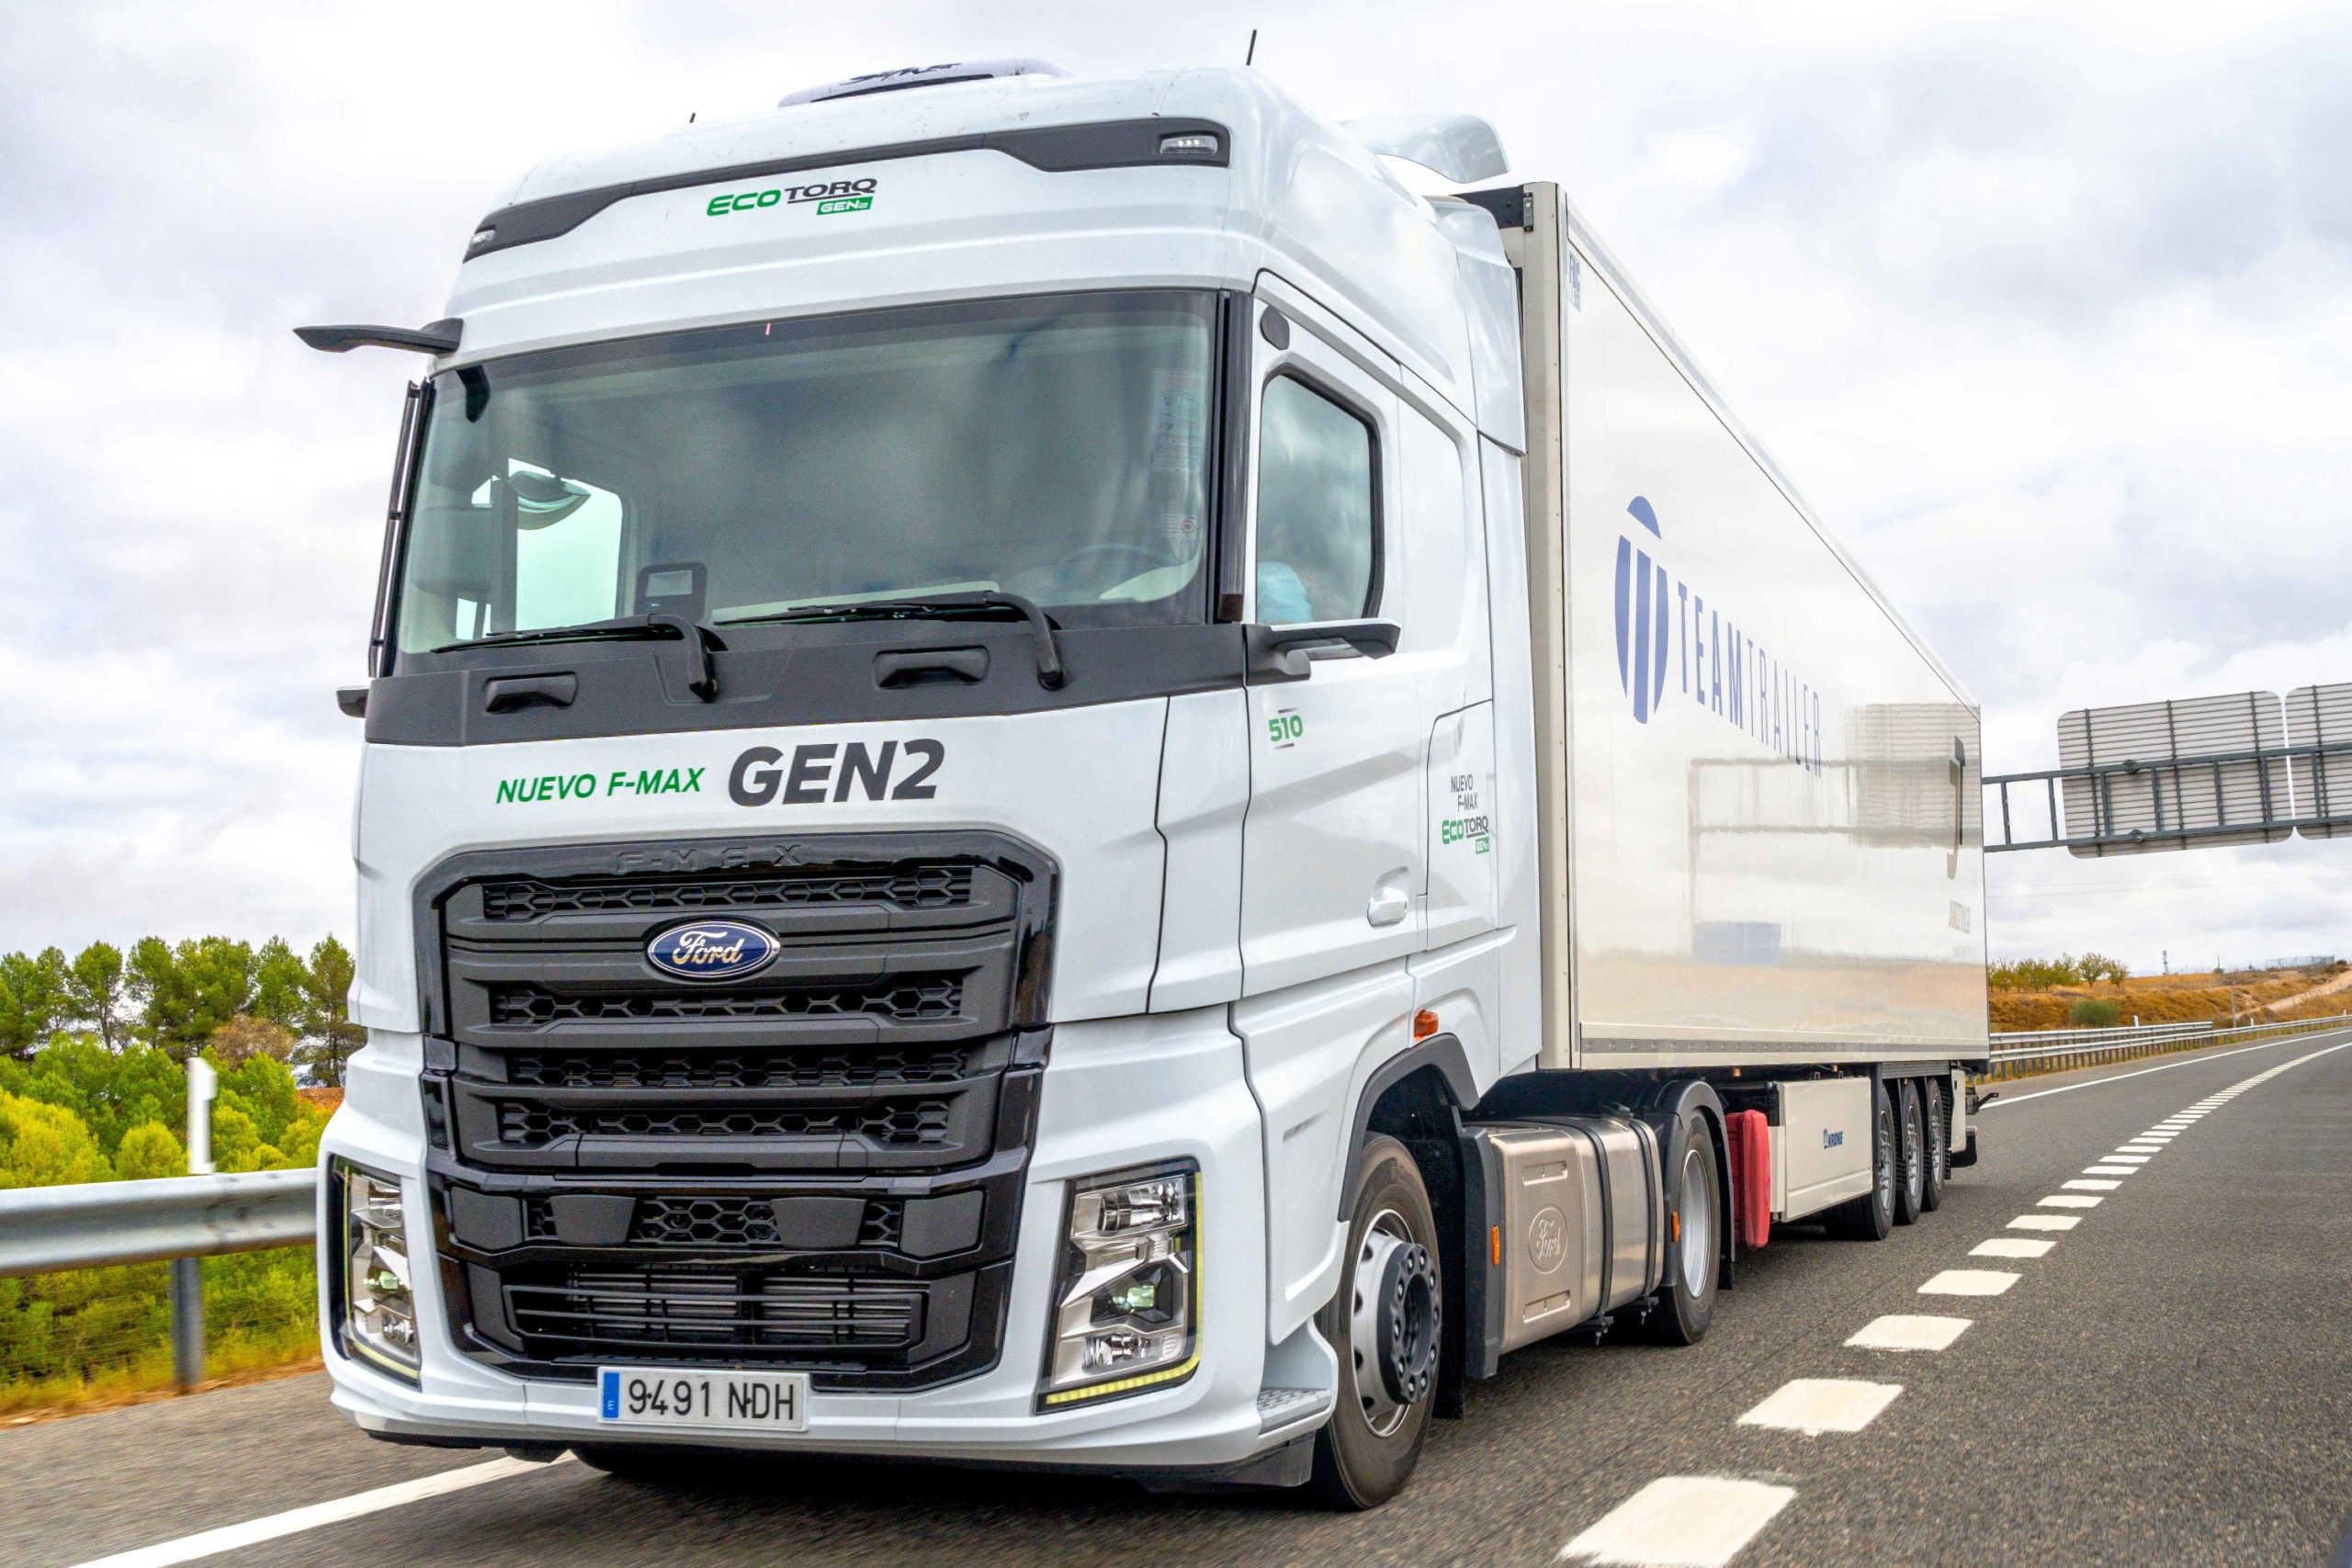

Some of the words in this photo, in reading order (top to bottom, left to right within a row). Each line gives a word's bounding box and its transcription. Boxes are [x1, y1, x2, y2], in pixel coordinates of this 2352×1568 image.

[820, 198, 869, 213] GEN2
[1268, 715, 1304, 742] 510
[495, 773, 596, 805] NUEVO
[607, 767, 706, 797] F-MAX
[727, 738, 945, 807] GEN2
[1451, 773, 1474, 793] NUEVO
[1457, 793, 1477, 812] F-MAX
[617, 844, 802, 873] F-MAX
[672, 931, 746, 964] Ford
[1536, 1219, 1561, 1260] Ford
[607, 1400, 615, 1411] E
[628, 1379, 710, 1417] 9491
[728, 1382, 795, 1420] NDH
